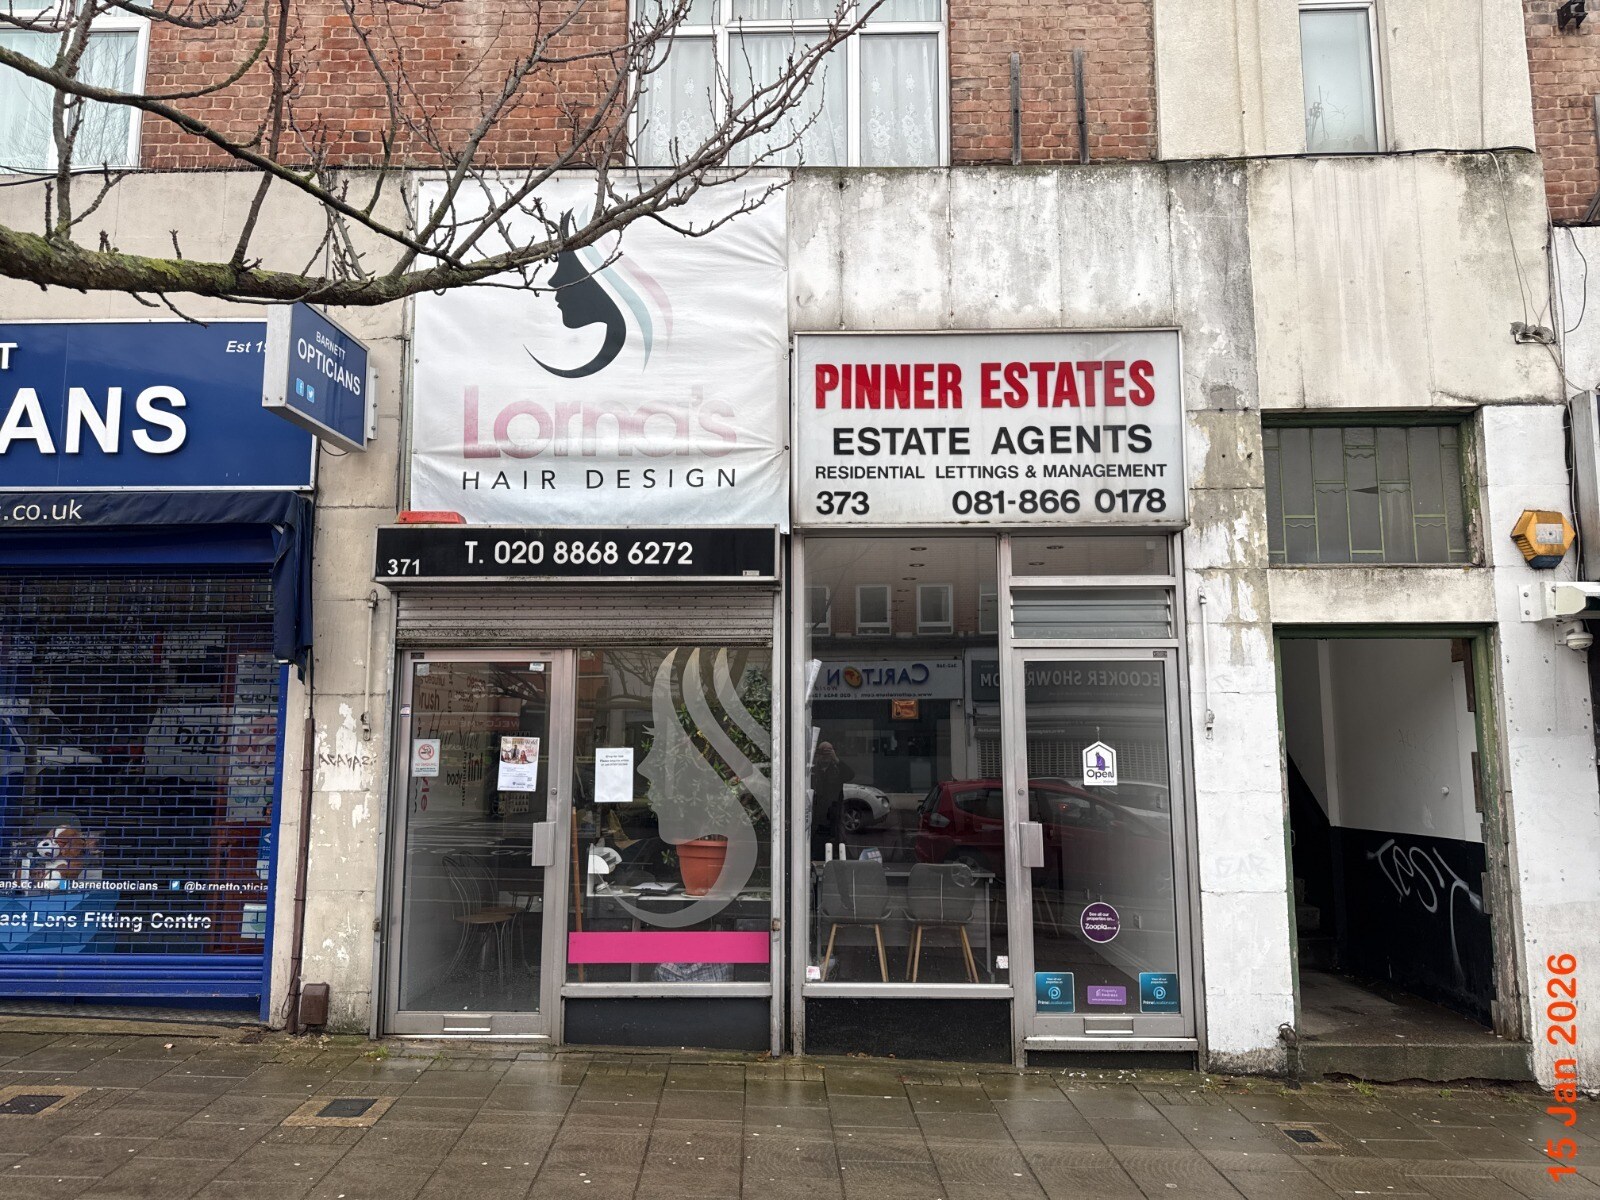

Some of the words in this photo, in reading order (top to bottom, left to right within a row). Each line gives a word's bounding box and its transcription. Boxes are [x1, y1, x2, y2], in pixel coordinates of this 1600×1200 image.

[226, 341, 251, 353] Est
[316, 331, 346, 360] BARNETT
[297, 337, 361, 396] OPTICIANS
[814, 363, 963, 409] PINNER
[980, 359, 1156, 409] ESTATES
[463, 384, 737, 460] Lorna's
[833, 426, 971, 456] ESTATE
[991, 423, 1153, 455] AGENTS
[462, 469, 557, 491] HAIR
[586, 467, 737, 490] DESIGN
[815, 464, 926, 480] RESIDENTIAL
[935, 464, 1019, 479] LETTINGS
[1025, 464, 1037, 479] &
[1043, 463, 1168, 479] MANAGEMENT
[815, 490, 871, 515] 373
[951, 488, 1081, 515] 081-866
[1094, 488, 1167, 514] 0178
[464, 540, 484, 565] T.
[493, 540, 545, 565] 020
[553, 540, 619, 566] 8868
[628, 541, 694, 566] 6272
[387, 558, 421, 576] 371
[1086, 769, 1115, 780] Open
[33, 911, 77, 928] Lens
[83, 911, 143, 933] Fitting
[150, 911, 212, 929] Centre
